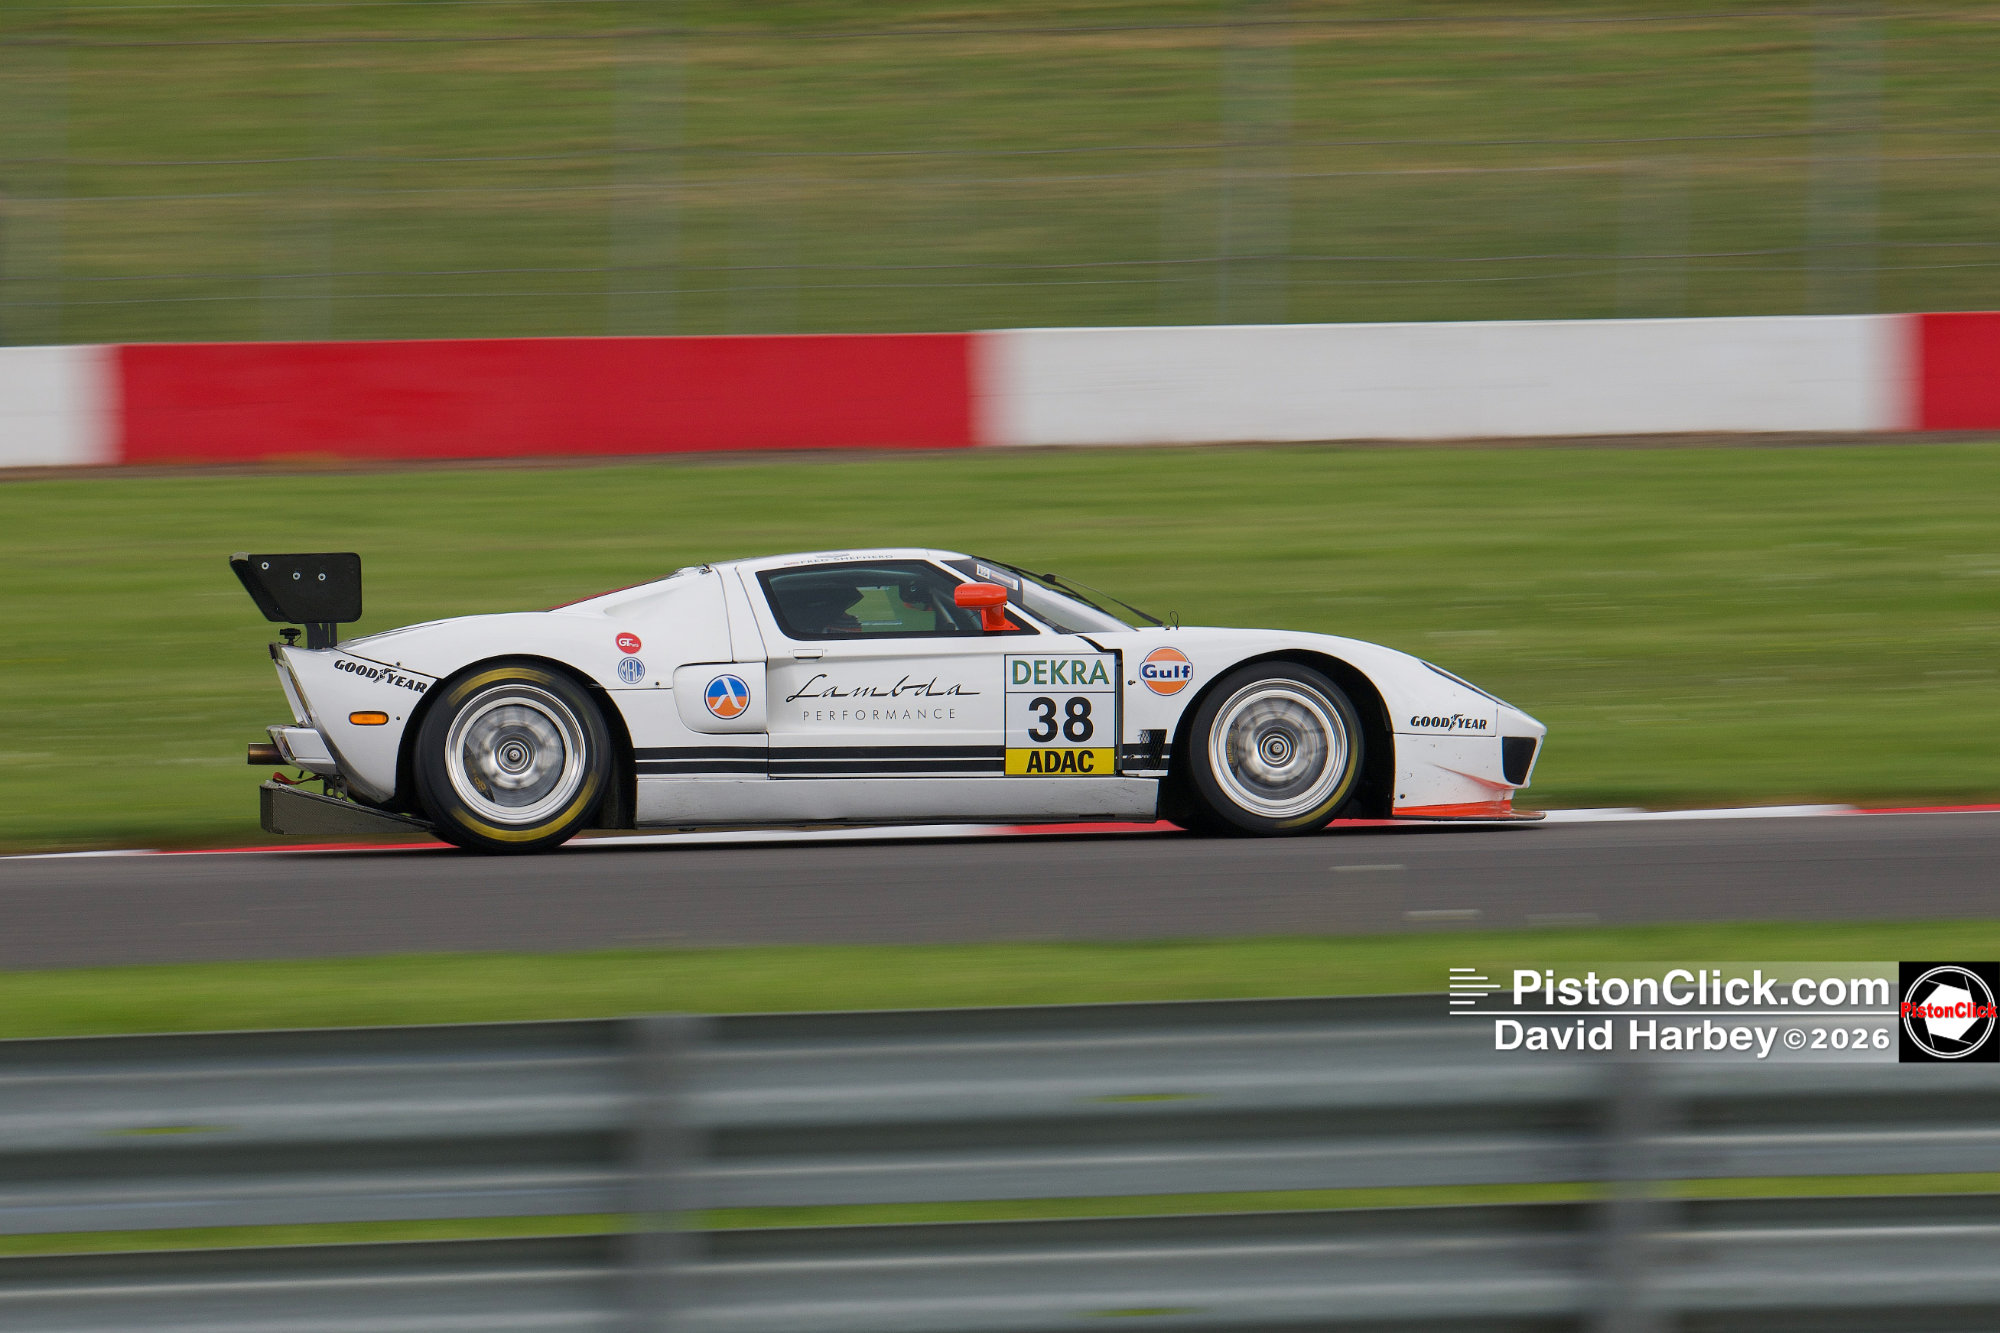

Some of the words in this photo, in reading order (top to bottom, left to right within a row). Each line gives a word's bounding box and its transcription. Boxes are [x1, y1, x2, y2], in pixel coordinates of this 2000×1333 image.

[1012, 659, 1110, 685] DEKRA
[1142, 664, 1190, 679] Gulf
[785, 673, 981, 702] Lambda
[803, 708, 956, 721] PERFORMANCE
[1028, 696, 1094, 743] 38
[1026, 750, 1095, 773] ADAC
